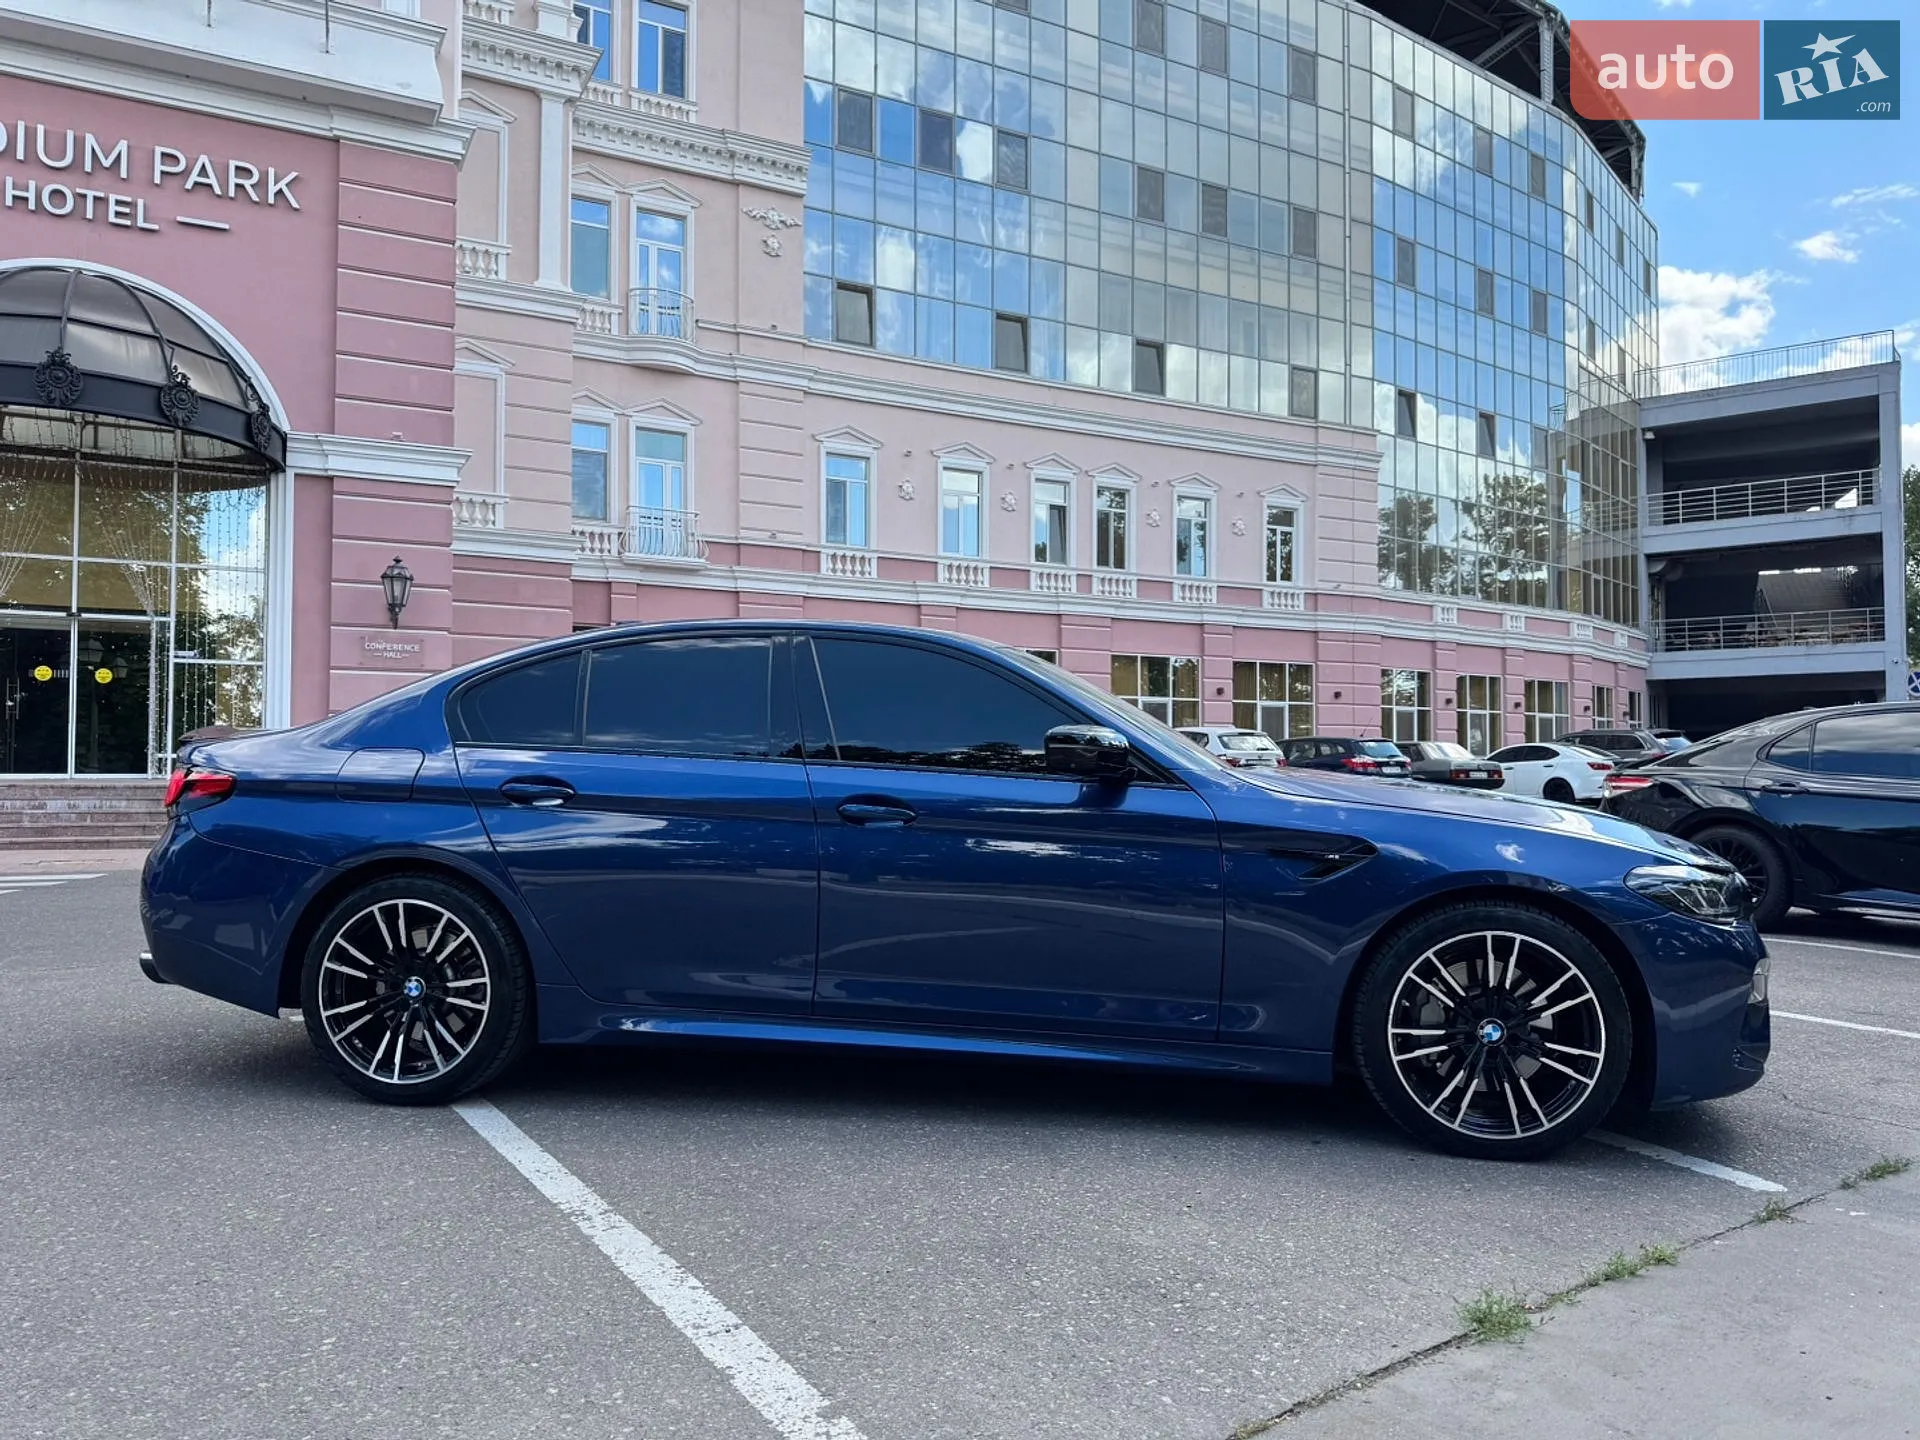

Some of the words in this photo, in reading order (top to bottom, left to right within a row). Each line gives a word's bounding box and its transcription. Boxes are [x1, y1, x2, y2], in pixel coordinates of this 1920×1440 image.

[0, 120, 129, 180] IUM
[153, 145, 301, 210] PARK
[5, 176, 160, 231] HOTEL
[365, 642, 420, 652] CONFERENCE
[383, 651, 402, 659] HALL
